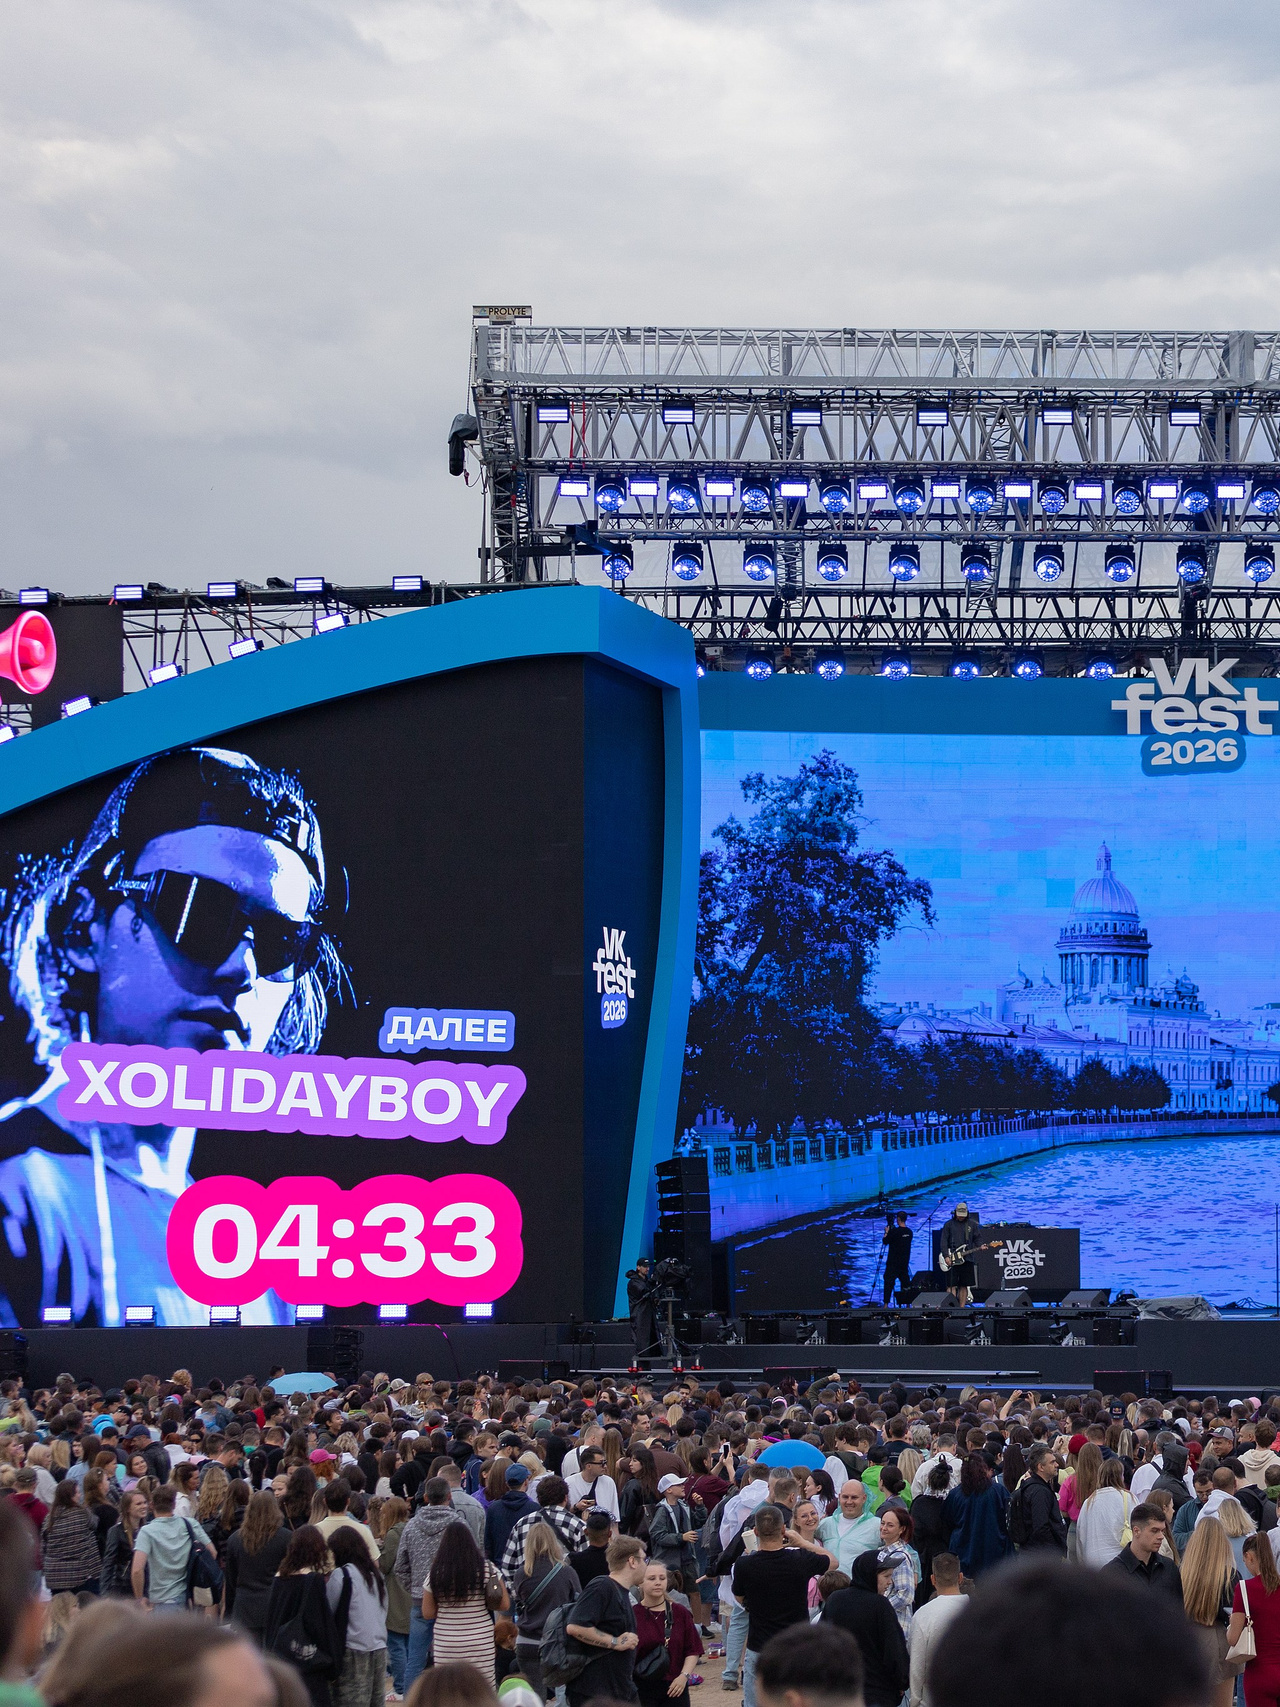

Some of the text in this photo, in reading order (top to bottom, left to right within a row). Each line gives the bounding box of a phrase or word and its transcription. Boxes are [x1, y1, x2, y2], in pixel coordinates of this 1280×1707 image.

[488, 307, 526, 316] PROLYTE
[1150, 658, 1241, 695] VK
[1111, 683, 1279, 735] fest
[1150, 738, 1238, 765] 2026
[603, 926, 627, 962] VK
[593, 948, 637, 999] fest
[603, 1000, 626, 1021] 2026
[386, 1015, 507, 1046] ДАЛЕЕ
[74, 1059, 509, 1127] XOLIDAYBOY
[193, 1202, 496, 1279] 04:33
[1006, 1240, 1033, 1252] VK
[994, 1248, 1046, 1266] fest
[1006, 1267, 1034, 1277] 2026
